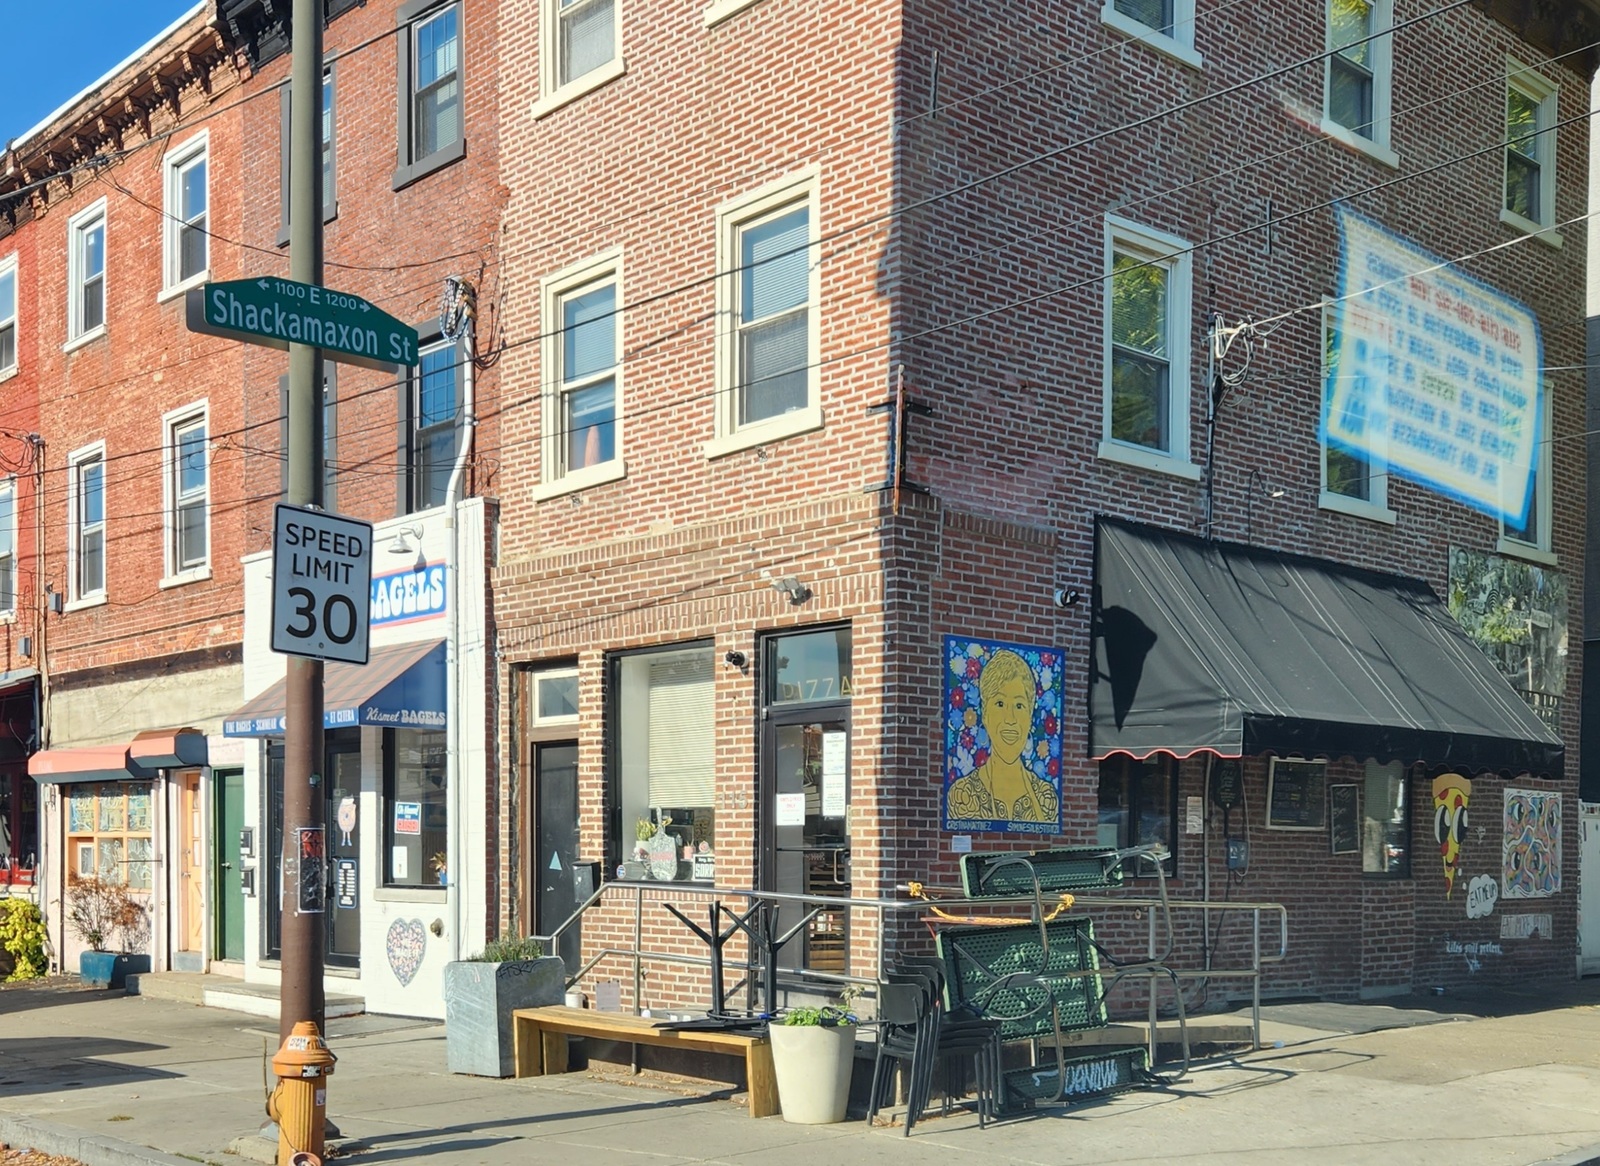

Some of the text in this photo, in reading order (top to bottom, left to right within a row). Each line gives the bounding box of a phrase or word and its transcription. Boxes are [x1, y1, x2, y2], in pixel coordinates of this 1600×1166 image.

[274, 281, 357, 310] 1100 E 1200
[212, 289, 411, 362] Shackamaxon St
[285, 523, 363, 558] SPEED
[292, 553, 354, 585] LIMIT
[285, 587, 357, 645] 30
[366, 706, 446, 726] Kismet BAGELS
